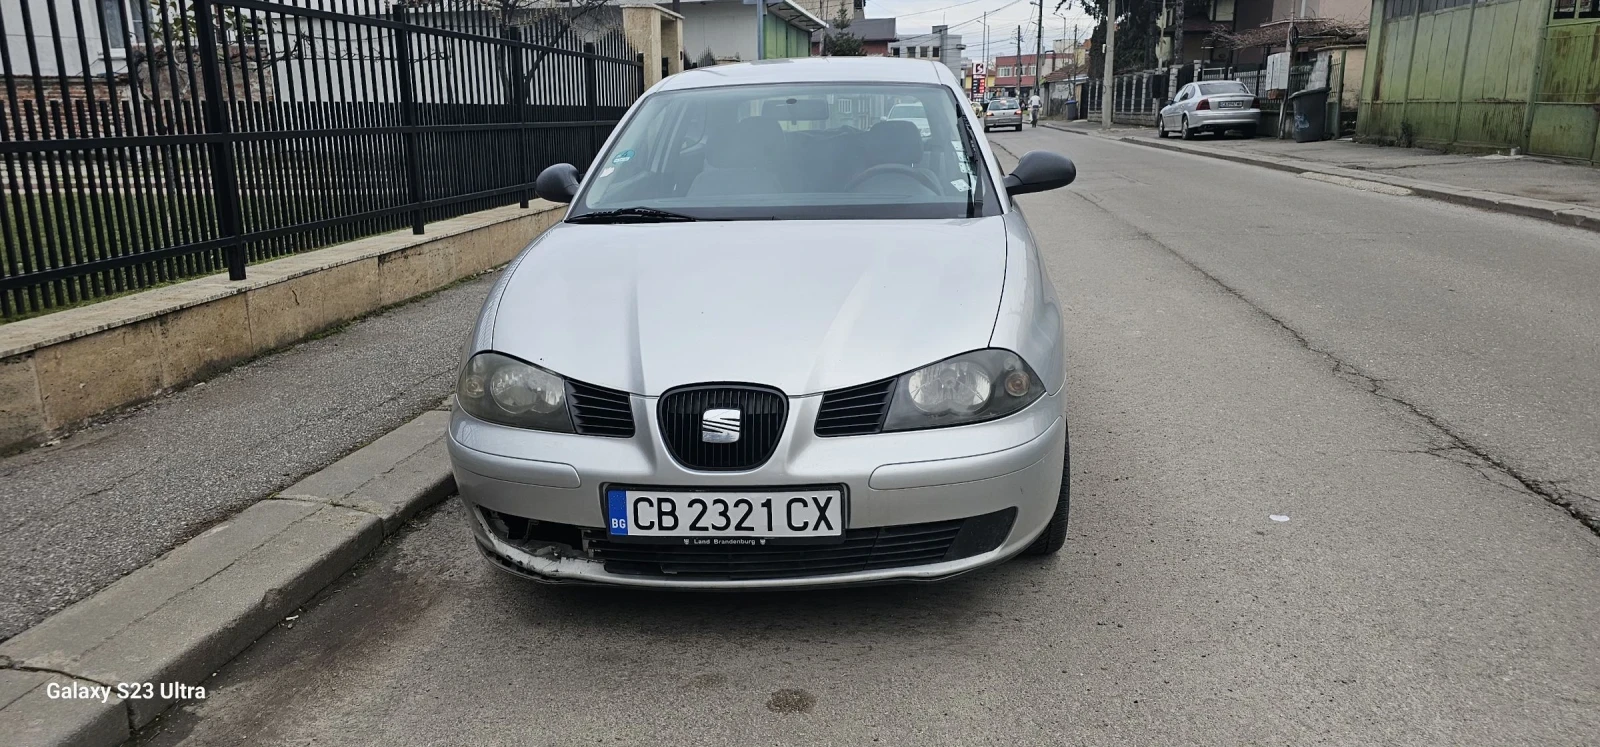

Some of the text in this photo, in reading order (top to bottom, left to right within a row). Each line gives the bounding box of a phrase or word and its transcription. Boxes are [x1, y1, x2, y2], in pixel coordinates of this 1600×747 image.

[633, 496, 834, 532] CB 2321 CX
[611, 518, 626, 529] BG
[713, 538, 756, 546] Brandenburg
